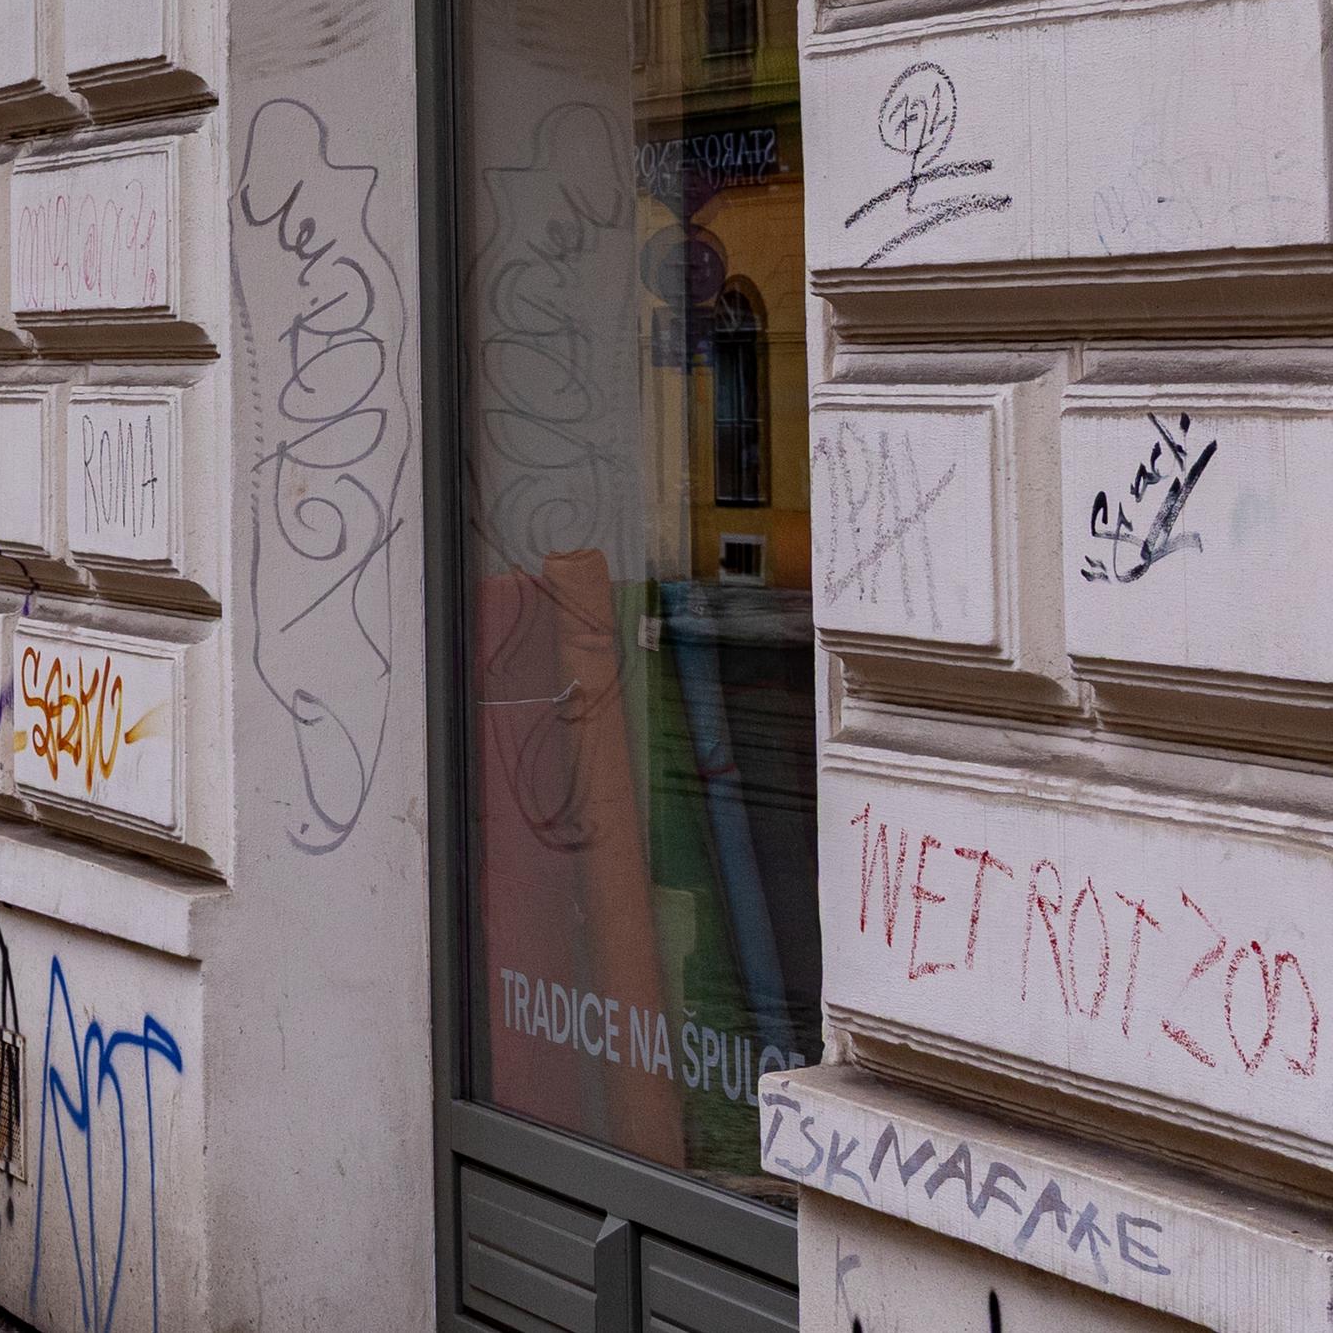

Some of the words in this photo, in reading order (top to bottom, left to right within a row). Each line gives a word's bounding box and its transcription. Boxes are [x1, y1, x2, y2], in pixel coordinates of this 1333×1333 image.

[81, 414, 158, 539] ROMA
[1021, 858, 1164, 1039] ROT
[500, 967, 621, 1064] TRADICE
[629, 1005, 674, 1081] NA
[680, 1006, 806, 1108] ŠPUL
